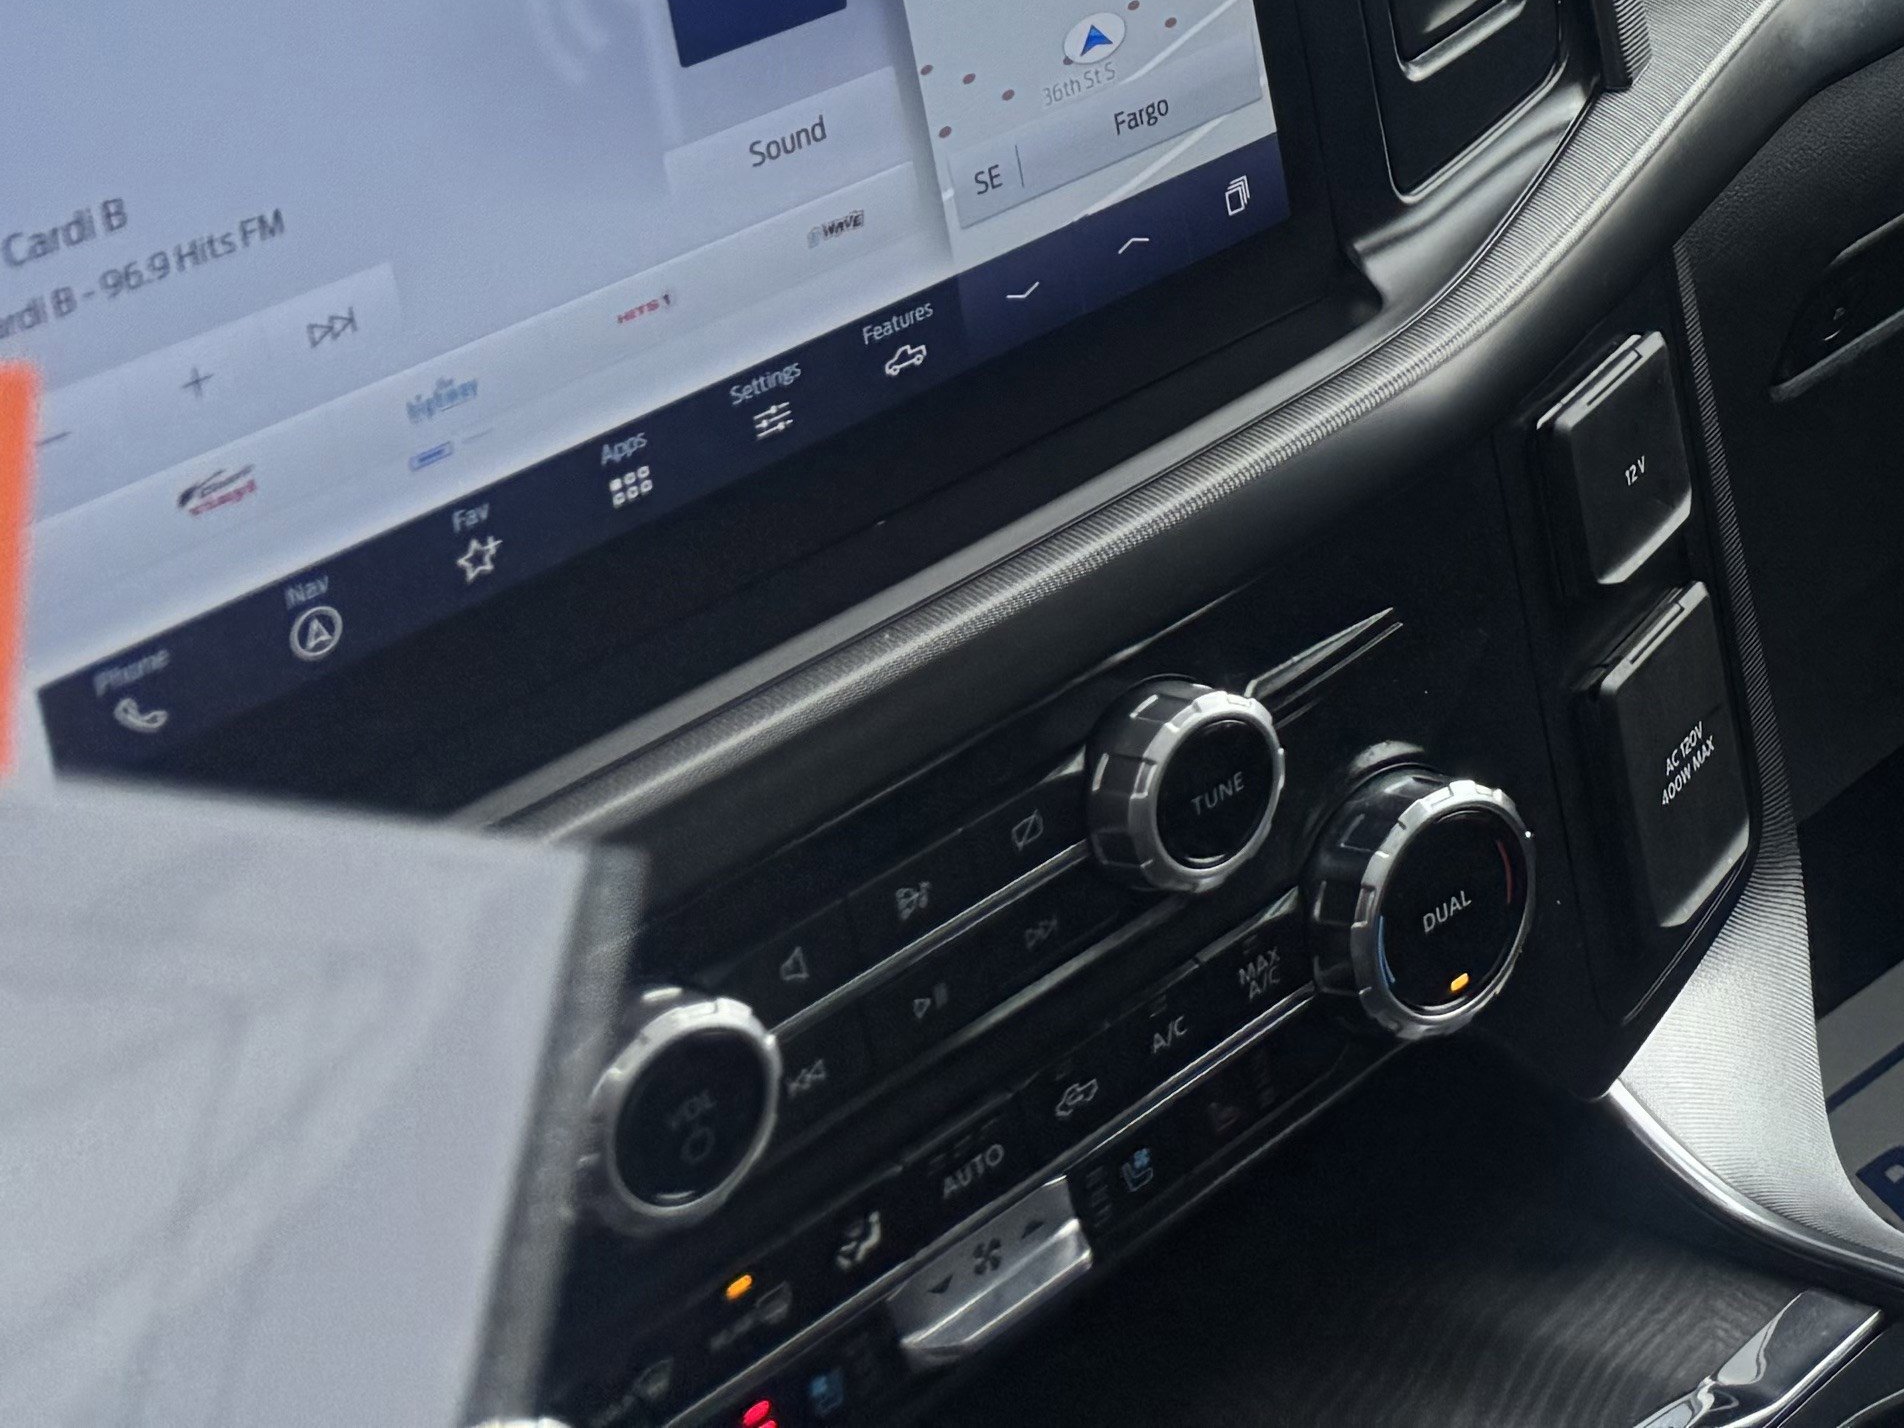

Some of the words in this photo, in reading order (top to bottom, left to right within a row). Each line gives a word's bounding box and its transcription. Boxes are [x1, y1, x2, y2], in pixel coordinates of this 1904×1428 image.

[1042, 78, 1081, 106] 36th
[1084, 69, 1100, 89] St
[1104, 61, 1116, 81] S
[1114, 99, 1169, 136] Fargo
[750, 117, 826, 166] Sound
[973, 164, 1003, 198] SE
[3, 207, 97, 267] Cardi
[101, 198, 128, 232] B
[0, 295, 48, 339] ardi
[51, 286, 77, 318] B
[99, 250, 171, 299] 96.9
[174, 232, 236, 273] Hits
[241, 210, 284, 246] FM
[863, 303, 932, 342] Features
[731, 363, 800, 404] Settings
[602, 431, 646, 465] Apps
[1624, 463, 1637, 486] 12
[1635, 455, 1646, 475] V
[453, 504, 488, 532] Fav
[288, 576, 327, 608] Nav
[95, 650, 168, 695] Phone
[1665, 748, 1679, 776] AC
[1679, 721, 1703, 760] 120V
[1661, 766, 1692, 806] 400W
[1691, 736, 1716, 774] MAX
[1191, 774, 1244, 812] TUNE
[1424, 890, 1471, 931] DUAL
[1239, 947, 1280, 984] MAX
[1247, 968, 1282, 999] A/C
[1151, 1017, 1187, 1053] A/C
[668, 1090, 711, 1128] VOL
[943, 1147, 1003, 1195] AUTO
